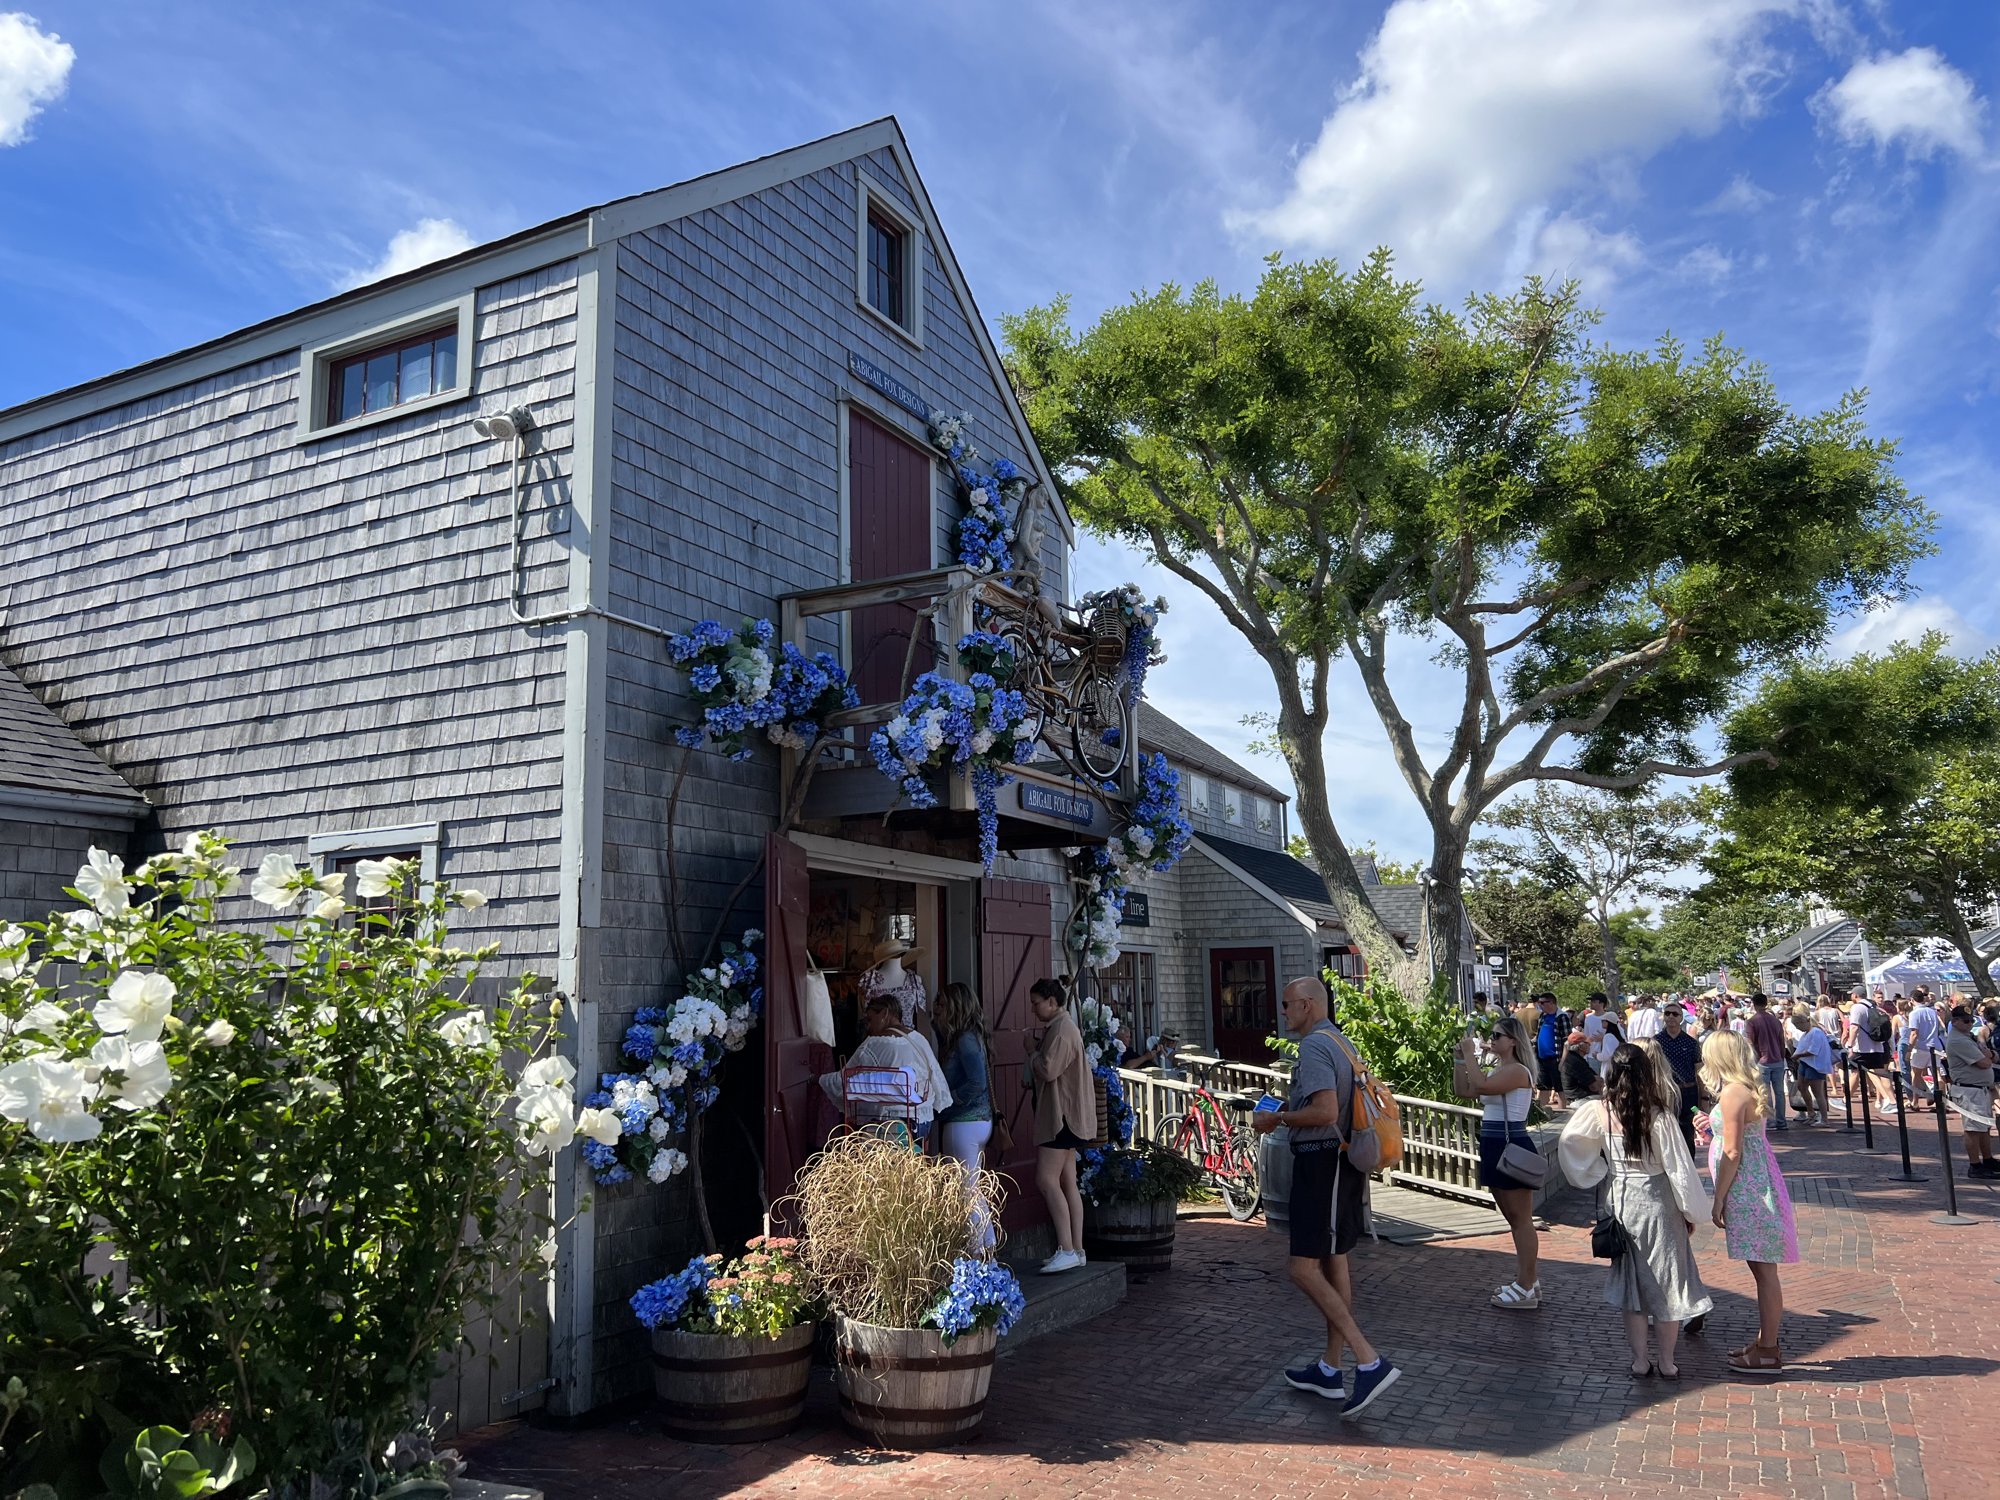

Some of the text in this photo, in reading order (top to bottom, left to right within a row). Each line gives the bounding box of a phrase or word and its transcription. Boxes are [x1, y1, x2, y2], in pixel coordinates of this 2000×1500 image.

[856, 360, 925, 416] ABIGAIL FOX DESIGNS
[1028, 789, 1053, 810] ABIGAIL
[1053, 795, 1066, 814] FOX
